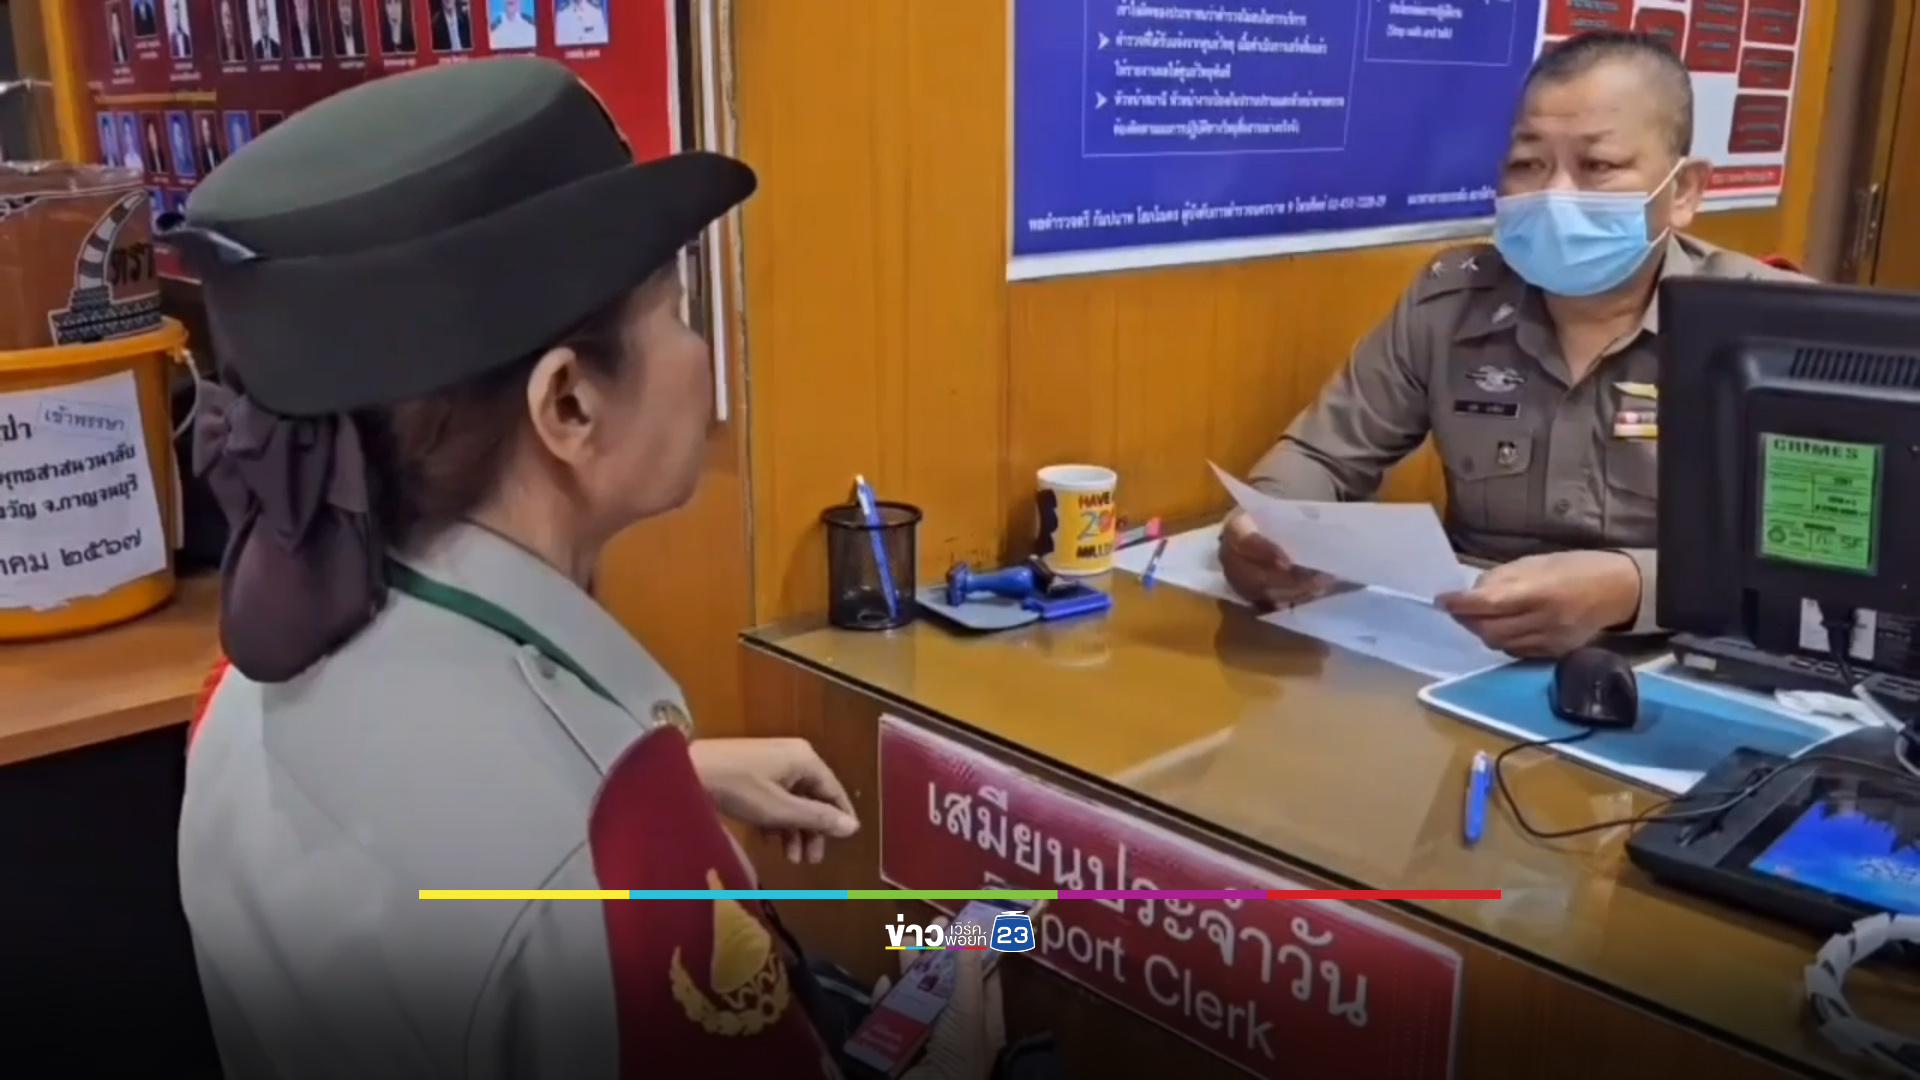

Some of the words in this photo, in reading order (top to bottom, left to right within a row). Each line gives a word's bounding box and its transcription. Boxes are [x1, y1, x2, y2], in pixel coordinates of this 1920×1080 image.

[1773, 438, 1860, 460] CRIMES
[59, 527, 142, 568] ๒๕๖๗
[928, 780, 1368, 1027] เสมียนประจำวัน
[1144, 955, 1277, 1061] Clerk
